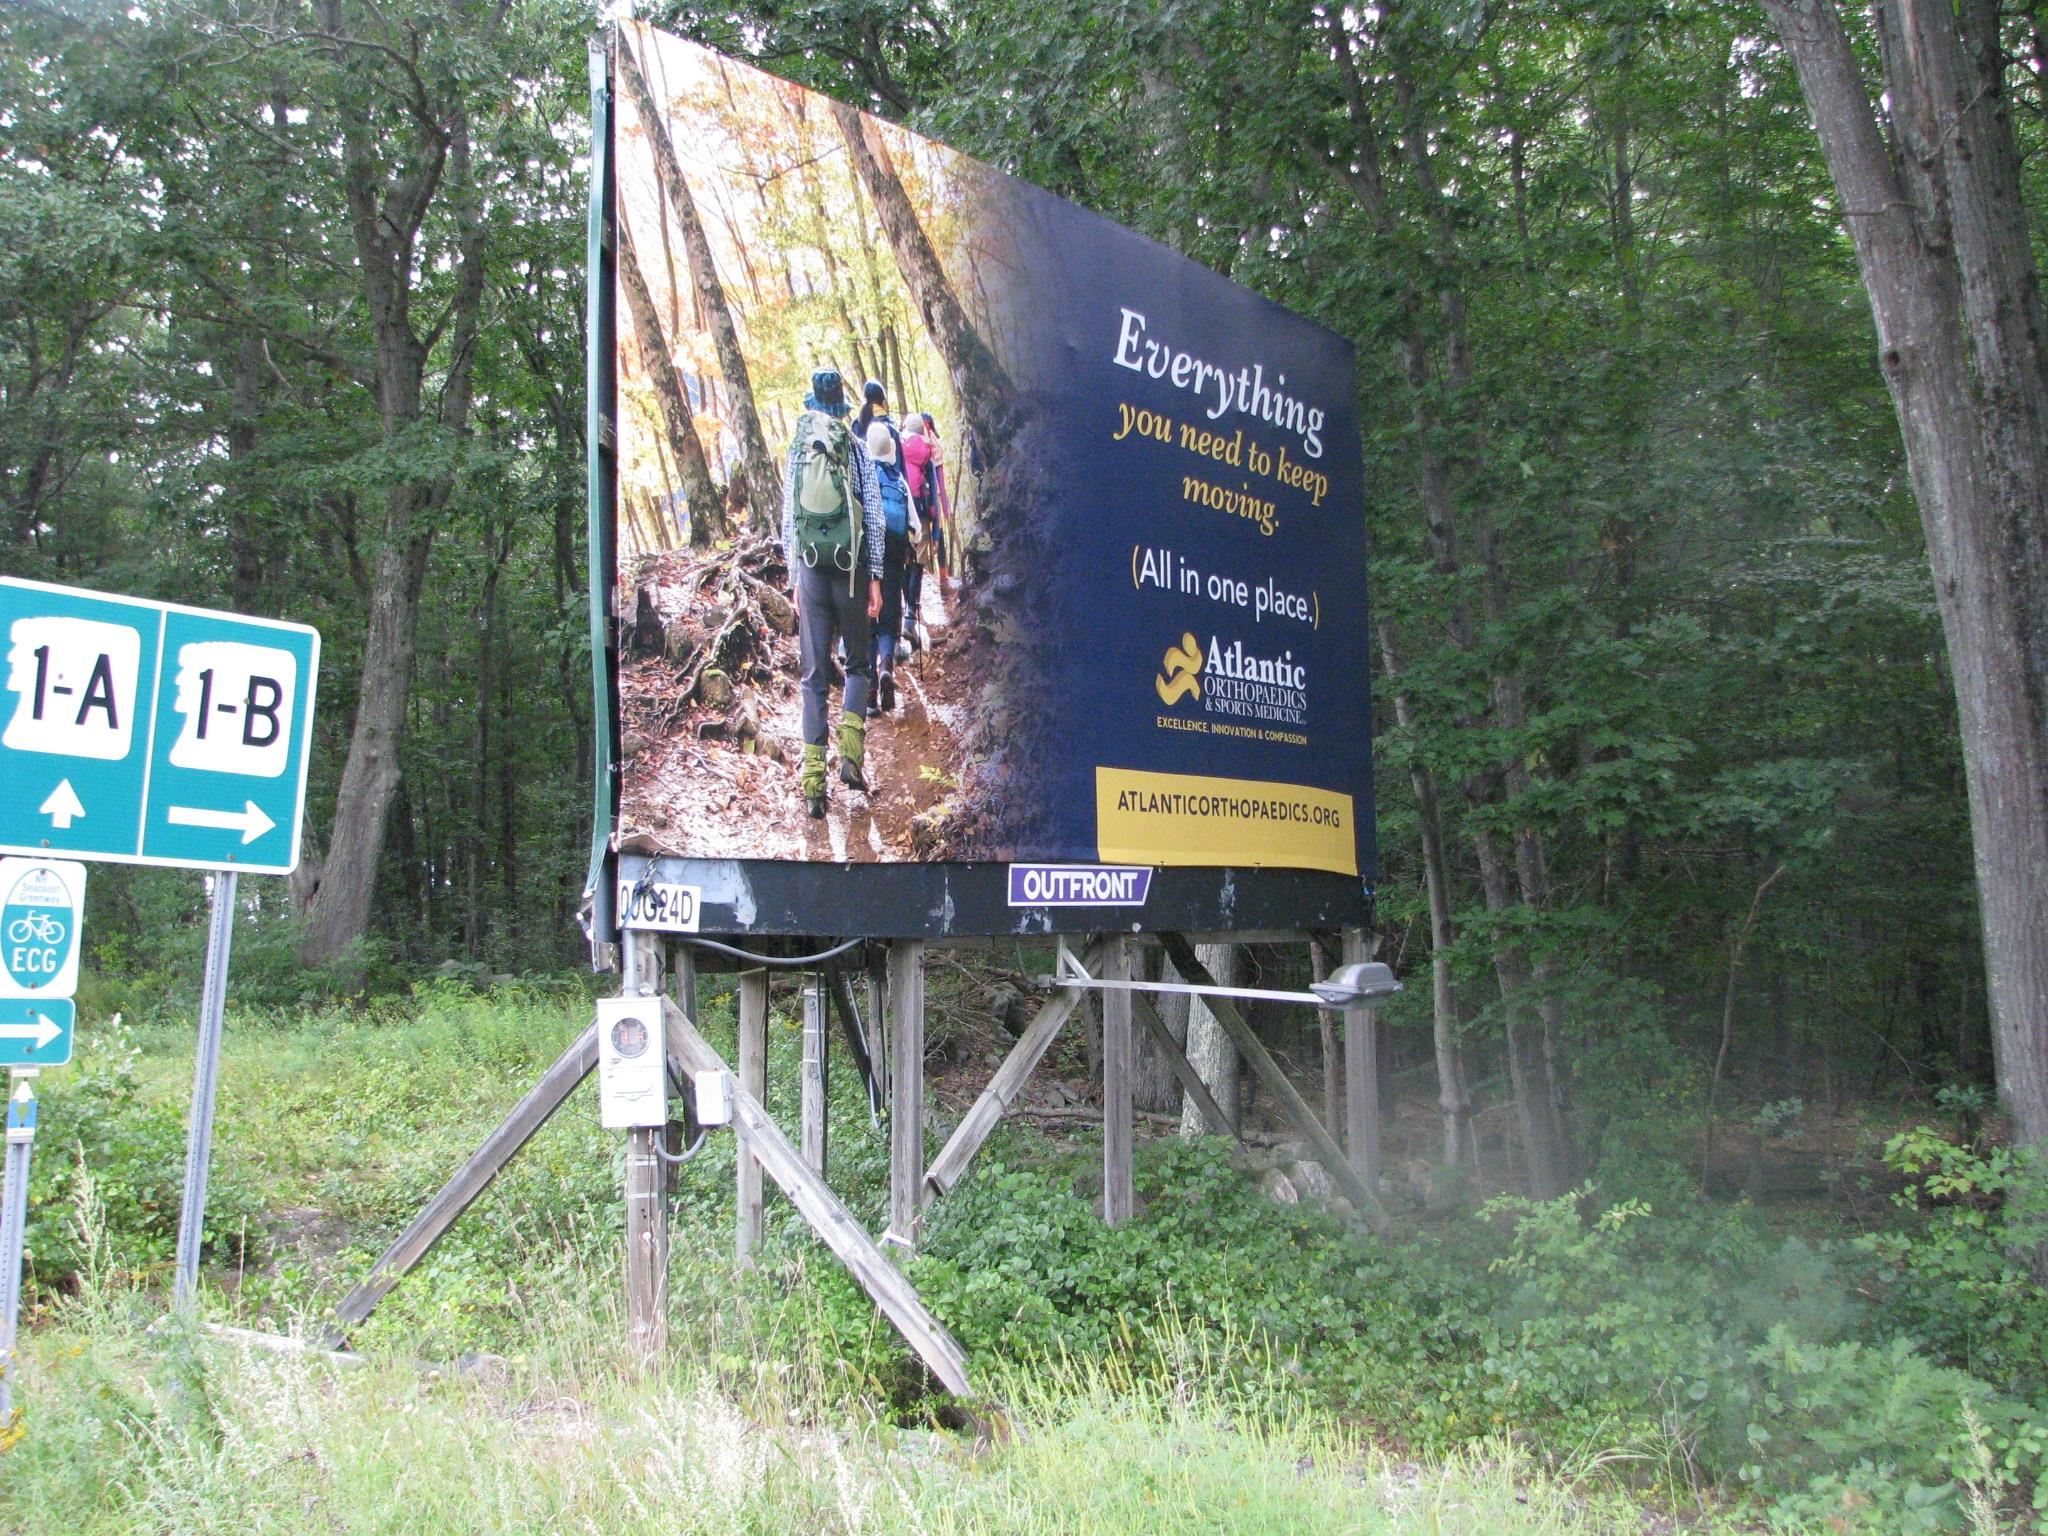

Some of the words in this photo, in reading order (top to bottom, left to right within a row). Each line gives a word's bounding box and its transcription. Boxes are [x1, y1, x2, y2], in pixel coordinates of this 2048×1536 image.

[1113, 307, 1325, 458] Everything
[1113, 403, 1172, 441] you
[1179, 421, 1242, 467] need
[1248, 442, 1271, 476] to
[1277, 447, 1328, 507] keep
[1183, 476, 1280, 536] moving.
[1132, 544, 1172, 590] (All
[1180, 556, 1200, 596] in
[1207, 575, 1248, 607] one
[1255, 577, 1319, 630] place.)
[32, 645, 119, 730] 1-A
[1204, 635, 1306, 690] Atlantic
[196, 668, 283, 748] 1-B
[1204, 676, 1307, 711] ORTHOPAEDICS
[1204, 698, 1213, 712] &
[1215, 699, 1253, 718] SPORTS
[1255, 704, 1302, 725] MEDICINE
[1211, 723, 1257, 740] INNOVATION
[1258, 730, 1264, 740] &
[1264, 730, 1308, 746] COMPASSION
[1117, 790, 1340, 828] ATLANTICORTHOPAEDICS.ORG
[1023, 870, 1138, 900] OUTFRONT
[12, 946, 57, 974] ECG
